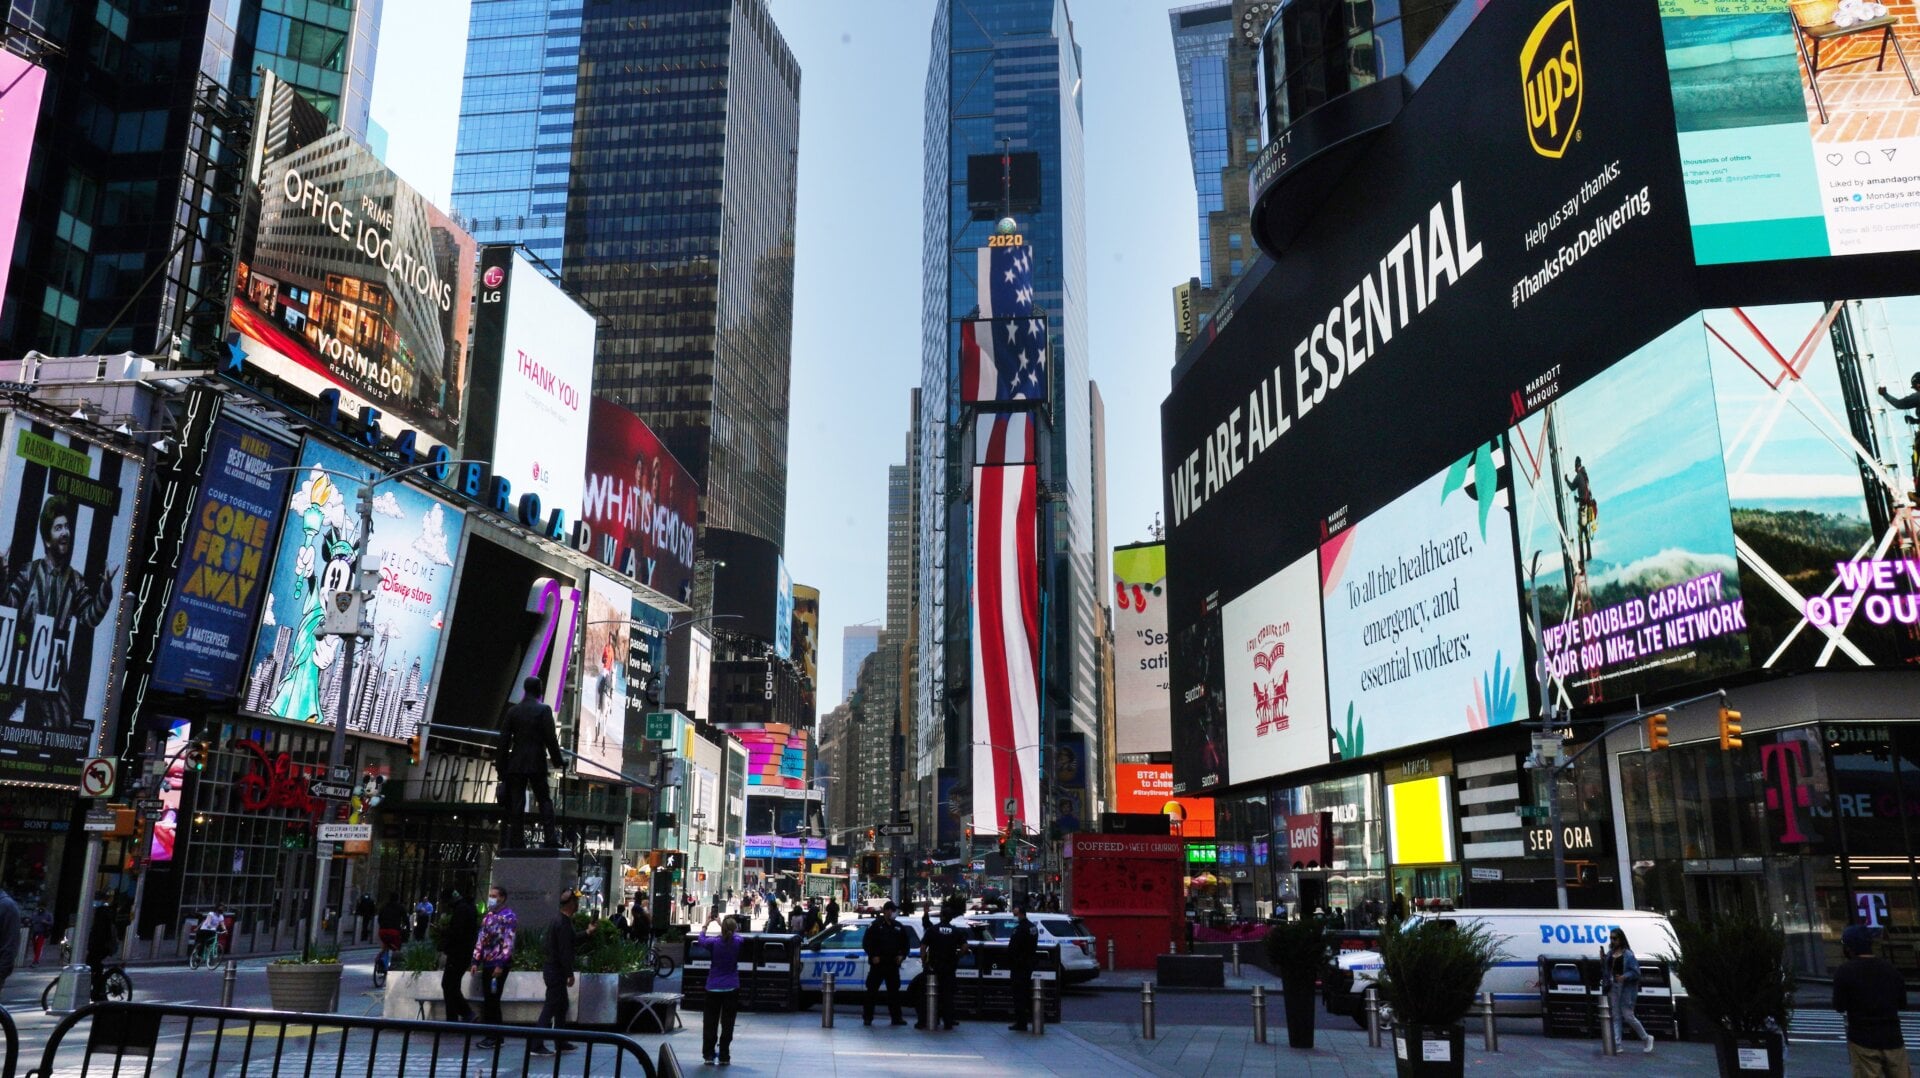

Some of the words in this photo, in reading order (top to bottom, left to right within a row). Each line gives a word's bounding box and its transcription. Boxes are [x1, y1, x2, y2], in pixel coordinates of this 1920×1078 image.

[1528, 41, 1577, 138] ups
[1252, 130, 1293, 174] MARRIOTT
[1683, 157, 1720, 166] thousands
[1729, 154, 1752, 162] others
[1254, 152, 1288, 194] MARQUIS
[1830, 180, 1852, 188] Liked
[1854, 179, 1865, 187] by
[361, 194, 393, 232] PRIME
[1525, 223, 1548, 251] Help
[1549, 212, 1561, 232] us
[1562, 195, 1580, 217] say
[1580, 160, 1622, 204] thanks:
[1832, 196, 1849, 204] ups
[1866, 191, 1905, 200] Mondays
[284, 168, 353, 242] OFFICE
[356, 219, 452, 312] LOCATIONS
[988, 234, 1024, 247] 2020
[1511, 185, 1651, 309] #ThanksForDelivering
[483, 290, 501, 304] LG
[1180, 288, 1191, 331] HOME
[317, 328, 402, 396] VORNADO
[1171, 447, 1202, 527] WE
[1204, 405, 1244, 502] ARE
[1248, 364, 1291, 465] ALL
[1294, 179, 1484, 420] ESSENTIAL
[329, 364, 361, 386] REALTY
[362, 381, 389, 402] TRUST
[517, 349, 557, 397] THANK
[558, 378, 579, 412] YOU
[1526, 363, 1561, 396] MARRIOTT
[1527, 382, 1559, 410] MARQUIS
[24, 436, 56, 461] RAISING
[56, 452, 84, 474] SPIRITS
[226, 447, 247, 469] BEST
[244, 455, 274, 481] MUSICAL
[319, 387, 451, 481] 1540
[457, 462, 657, 587] BROADWAY
[540, 468, 549, 483] LG
[208, 487, 228, 502] COME
[229, 496, 263, 516] TOGETHER
[262, 510, 273, 519] AT
[1328, 504, 1349, 522] MARRIOTT
[202, 500, 269, 549] COME
[582, 472, 641, 534] WHAT
[640, 490, 652, 535] IS
[652, 503, 680, 556] MEMO
[679, 517, 694, 569] 618
[1328, 517, 1348, 534] MARQUIS
[192, 530, 263, 577] FROM
[381, 548, 435, 582] WELCOME
[1346, 579, 1362, 610] To
[1361, 570, 1377, 604] all
[1378, 563, 1398, 595] the
[1398, 530, 1474, 587] healthcare,
[183, 564, 257, 609] AWAY
[382, 567, 411, 604] Disney
[411, 587, 433, 605] store
[190, 598, 219, 612] REMARKABLE
[404, 602, 432, 619] SQUARE
[1362, 600, 1431, 647] emergency,
[1432, 577, 1461, 619] and
[1543, 619, 1581, 652] WE'VE
[1582, 599, 1646, 641] DOUBLED
[1648, 572, 1722, 621] CAPACITY
[1806, 595, 1853, 626] OF
[1865, 593, 1920, 625] OU
[525, 576, 582, 714] 21
[630, 638, 649, 654] passion
[1552, 650, 1580, 679] OUR
[1580, 642, 1604, 672] 600
[1606, 634, 1636, 665] MHz
[1637, 622, 1664, 656] LTE
[1665, 599, 1748, 648] NETWORK
[629, 653, 641, 670] love
[640, 658, 652, 674] into
[1140, 651, 1168, 670] sati
[1360, 648, 1411, 692] essential
[1411, 632, 1472, 674] workers:
[631, 677, 640, 689] we
[764, 662, 774, 700] 1500
[0, 726, 43, 746] -DROPPING
[314, 785, 328, 794] ONE
[333, 787, 348, 796] WAY
[1136, 770, 1158, 779] BT21
[1141, 779, 1151, 788] to
[23, 820, 49, 830] SONY
[1529, 826, 1593, 850] SEPORA
[1077, 841, 1125, 852] COFFEED
[938, 926, 953, 934] NYPD
[812, 961, 857, 978] NYPD
